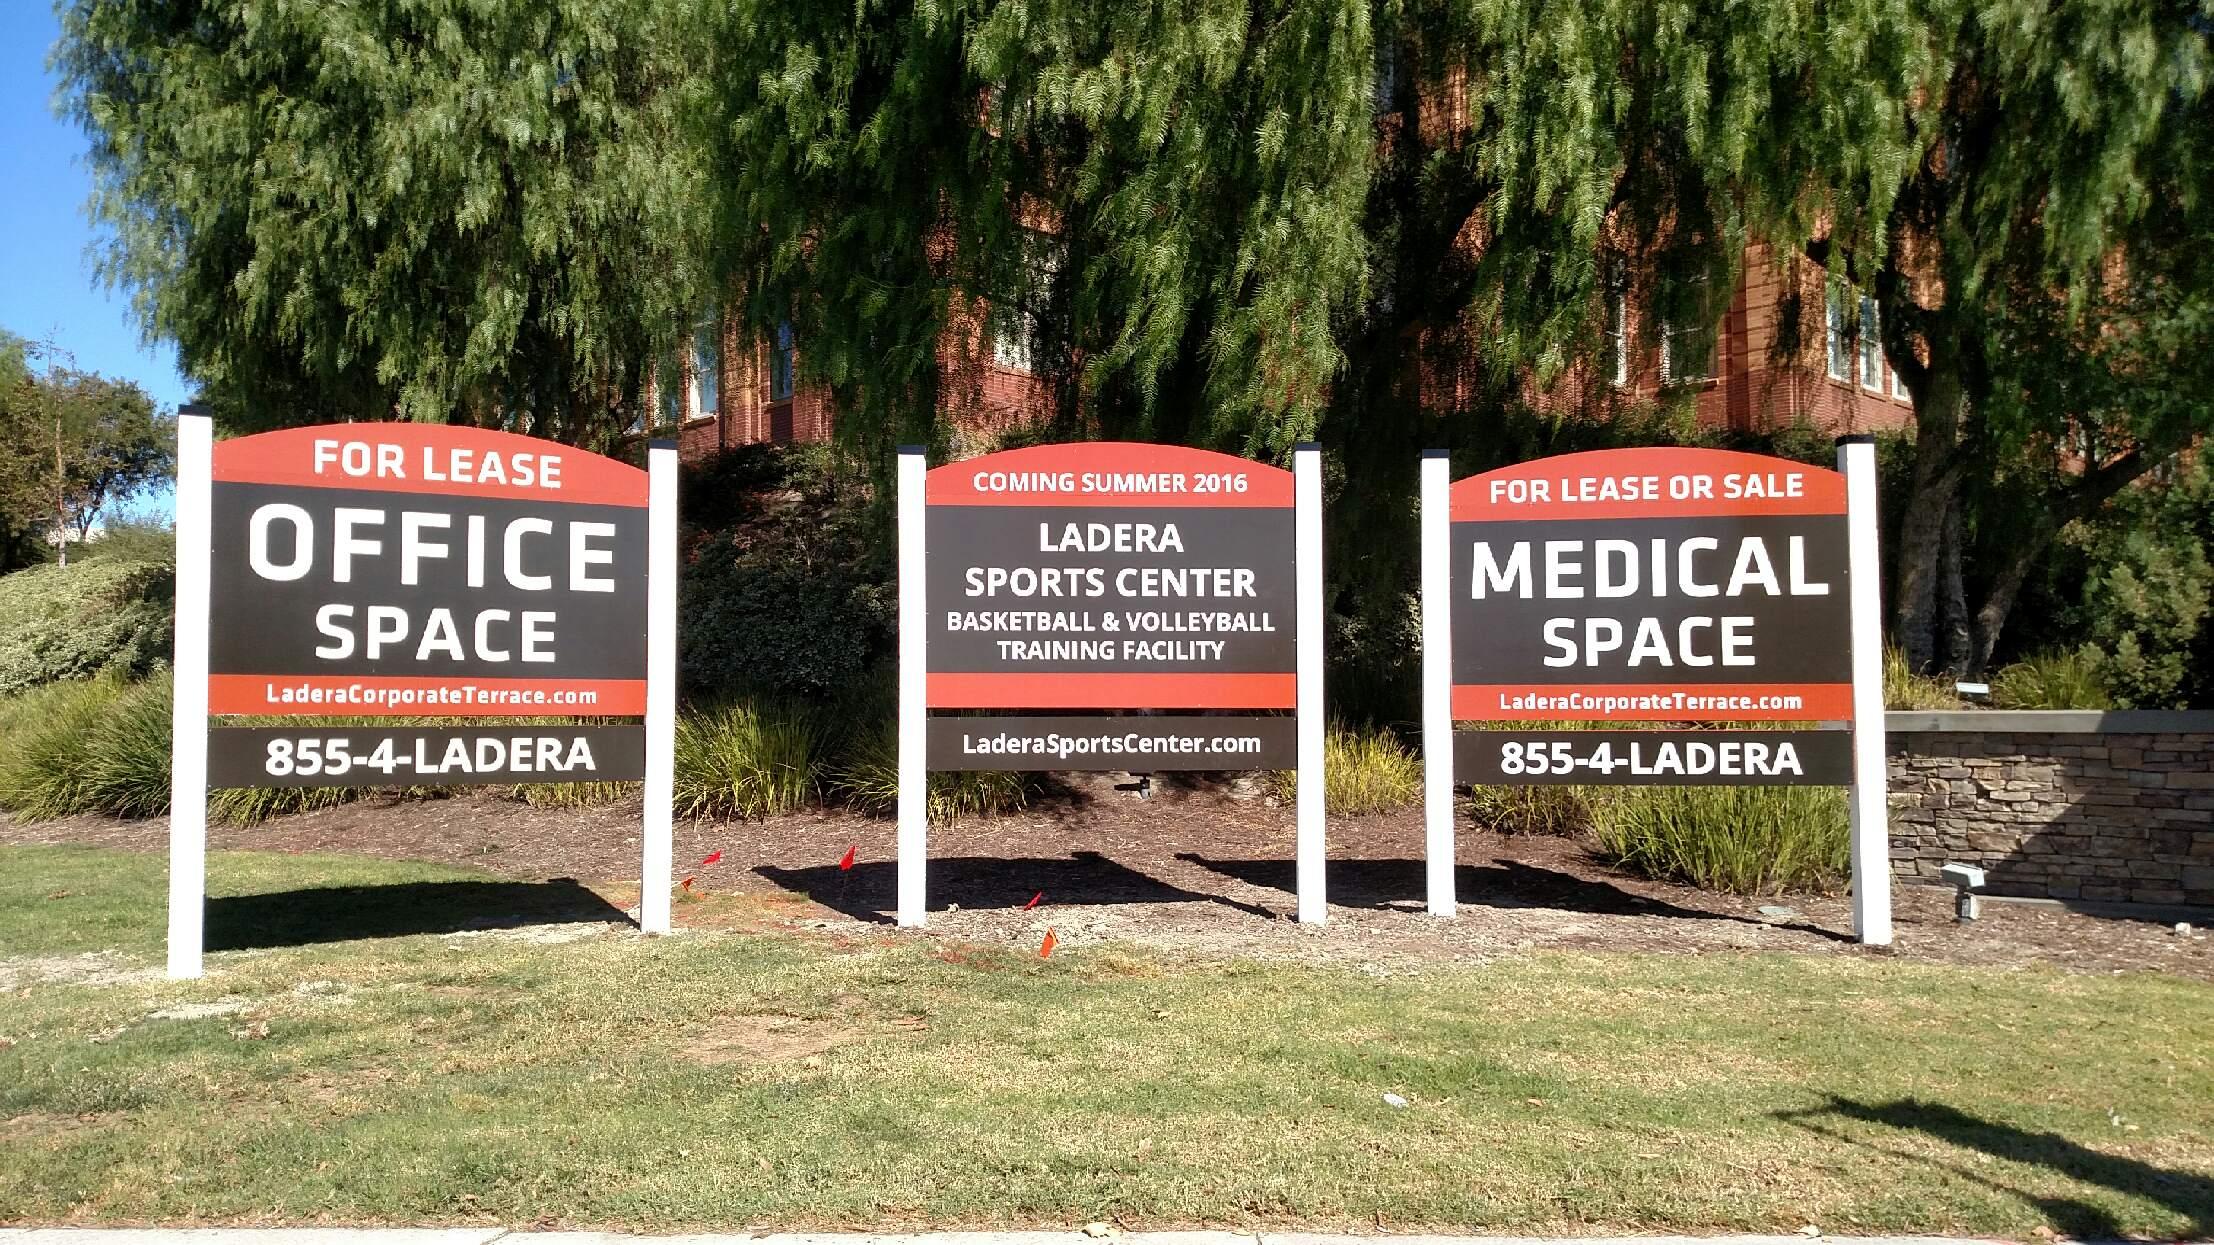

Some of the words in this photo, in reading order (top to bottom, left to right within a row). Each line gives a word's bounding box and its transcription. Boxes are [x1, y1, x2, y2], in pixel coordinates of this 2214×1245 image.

[314, 438, 407, 480] FOR
[423, 446, 562, 491] LEASE
[973, 471, 1075, 493] COMING
[1081, 472, 1189, 493] SUMMER
[1192, 472, 1249, 494] 2016
[1490, 479, 1552, 505] FOR
[1560, 475, 1660, 503] LEASE
[1669, 474, 1715, 500] OR
[1723, 472, 1804, 499] SALE
[249, 503, 617, 593] OFFICE
[1039, 522, 1185, 553] LADERA
[965, 566, 1105, 597] SPORTS
[1115, 567, 1257, 598] CENTER
[1471, 535, 1830, 600] MEDICAL
[315, 603, 557, 663] SPACE
[947, 611, 1097, 632] BASKETBALL
[1101, 611, 1121, 632] &
[1125, 611, 1276, 632] VOLLEYBALL
[996, 640, 1115, 661] TRAINING
[1122, 640, 1226, 661] FACILITY
[1543, 616, 1756, 668] SPACE
[266, 683, 597, 709] LaderaCorporateTerrace.com
[1500, 692, 1803, 714] LaderaCorporateTerrace.com
[265, 736, 597, 777] 855-4-LADERA
[963, 732, 1261, 760] LaderaSportsCenter.com
[1500, 741, 1804, 776] 855-4-LADERA
